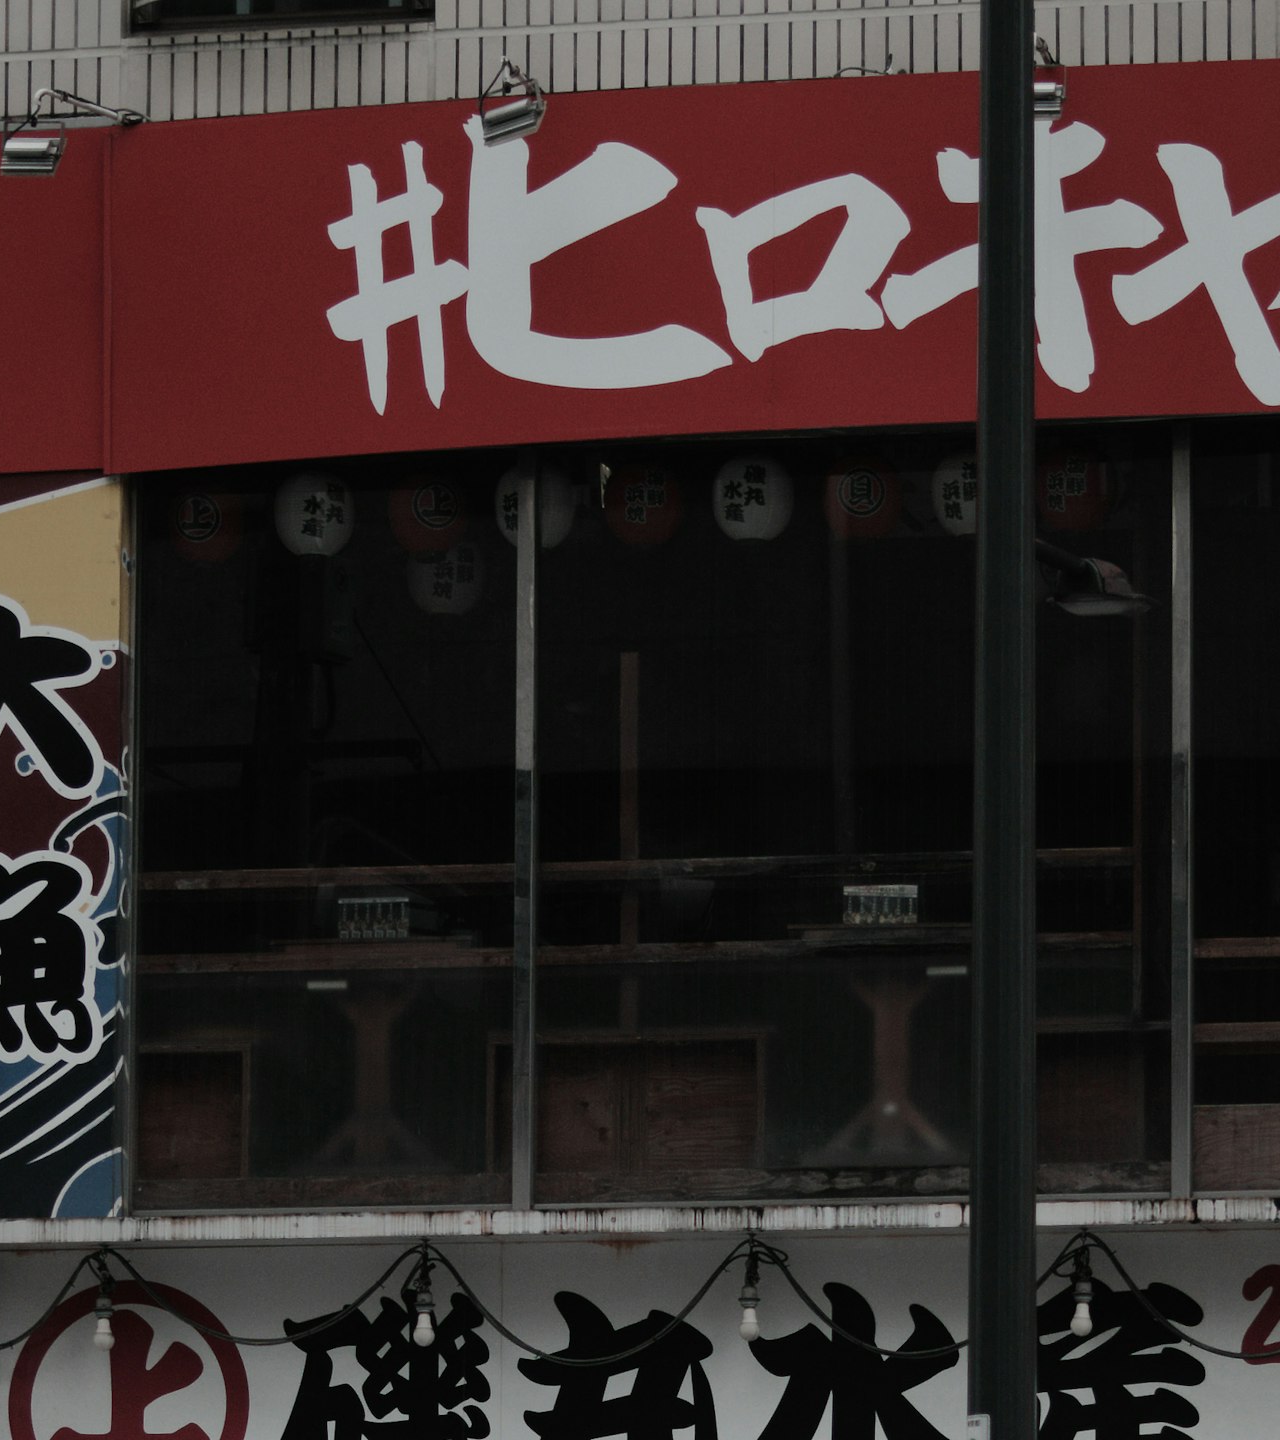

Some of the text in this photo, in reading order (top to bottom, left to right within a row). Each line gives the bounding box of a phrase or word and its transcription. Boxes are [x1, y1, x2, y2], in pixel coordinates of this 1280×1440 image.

[626, 486, 646, 523] 浜焼
[724, 480, 744, 522] 水産
[745, 465, 766, 506] 磯丸
